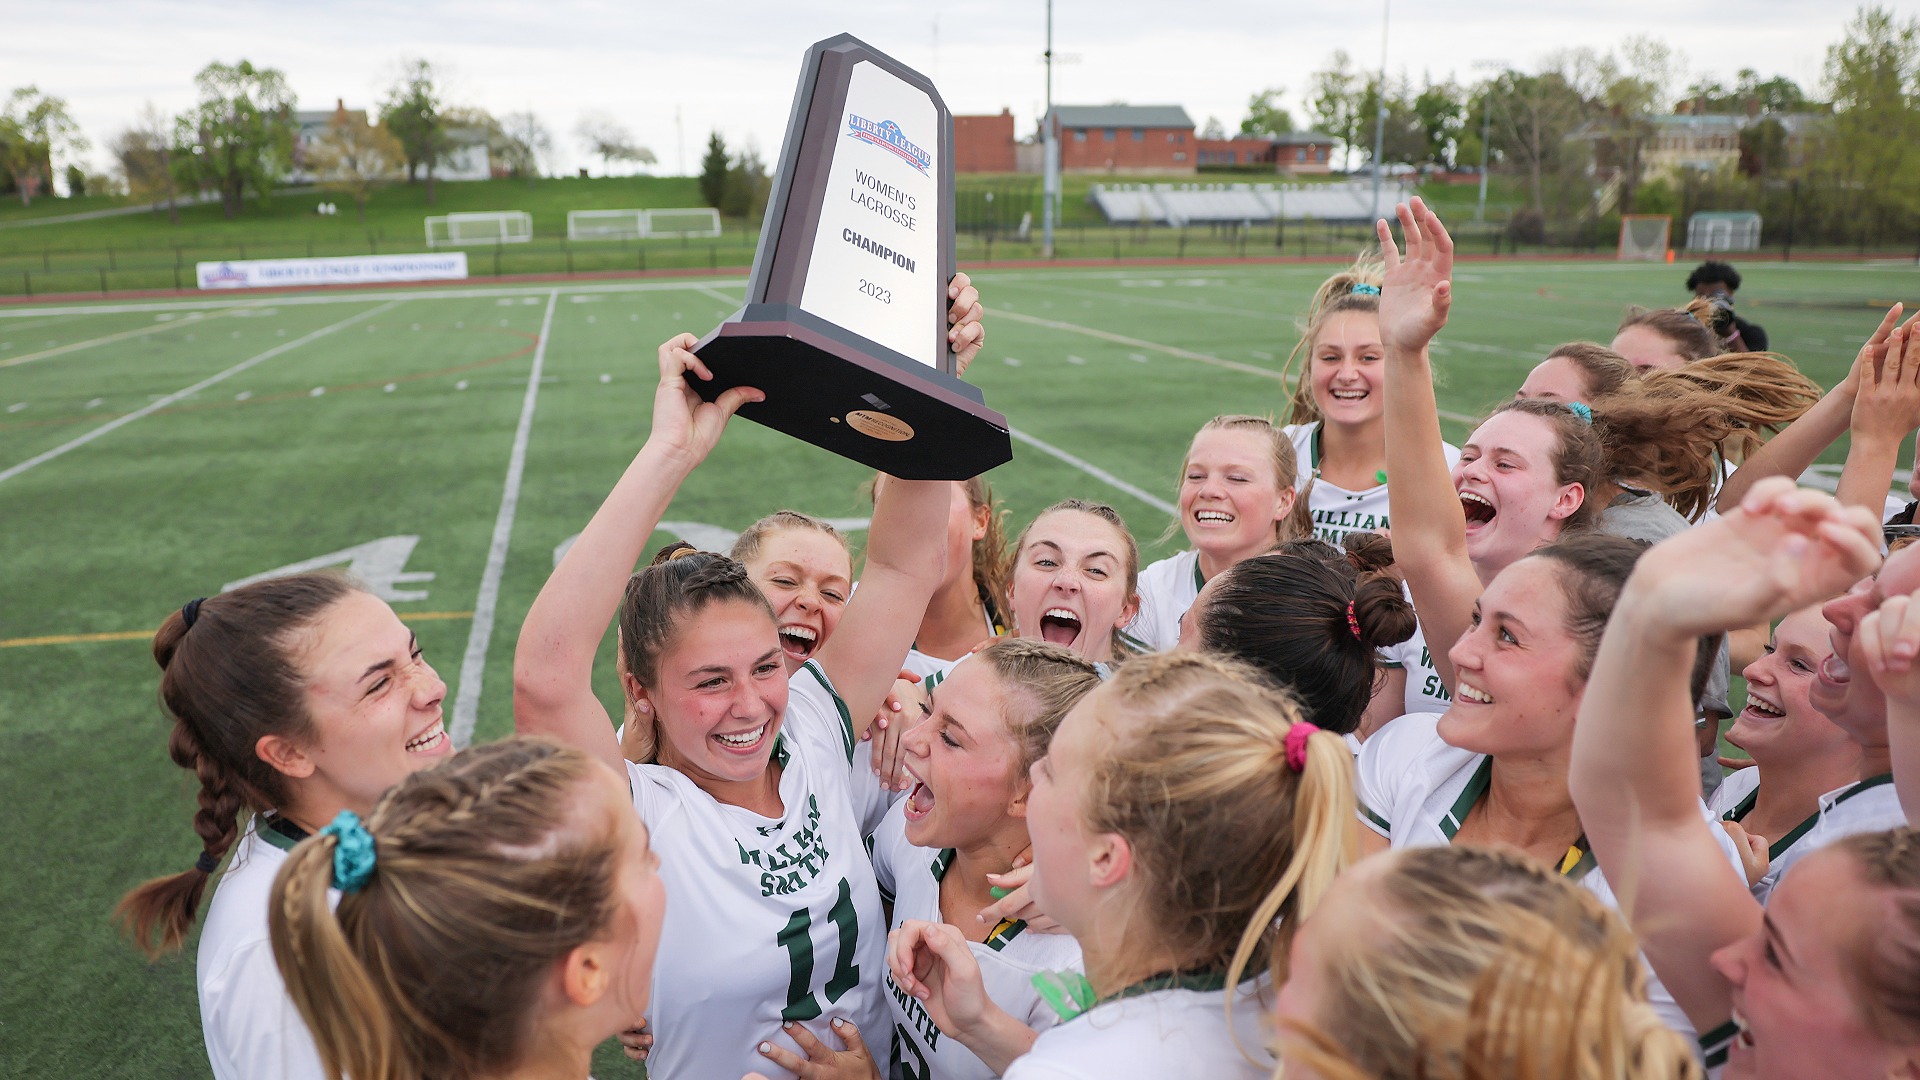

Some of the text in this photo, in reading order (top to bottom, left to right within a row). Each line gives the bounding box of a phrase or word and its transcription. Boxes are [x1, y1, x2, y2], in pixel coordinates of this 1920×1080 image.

[850, 114, 892, 141] LIBERTY
[894, 135, 930, 163] LEAGUE
[850, 187, 917, 232] LACROSSE
[855, 168, 916, 211] WOMEN'S
[842, 227, 916, 274] CHAMPION
[858, 278, 892, 305] 2023
[1311, 508, 1390, 530] ILLIAM
[760, 833, 830, 897] SMTH
[777, 876, 860, 1023] 11
